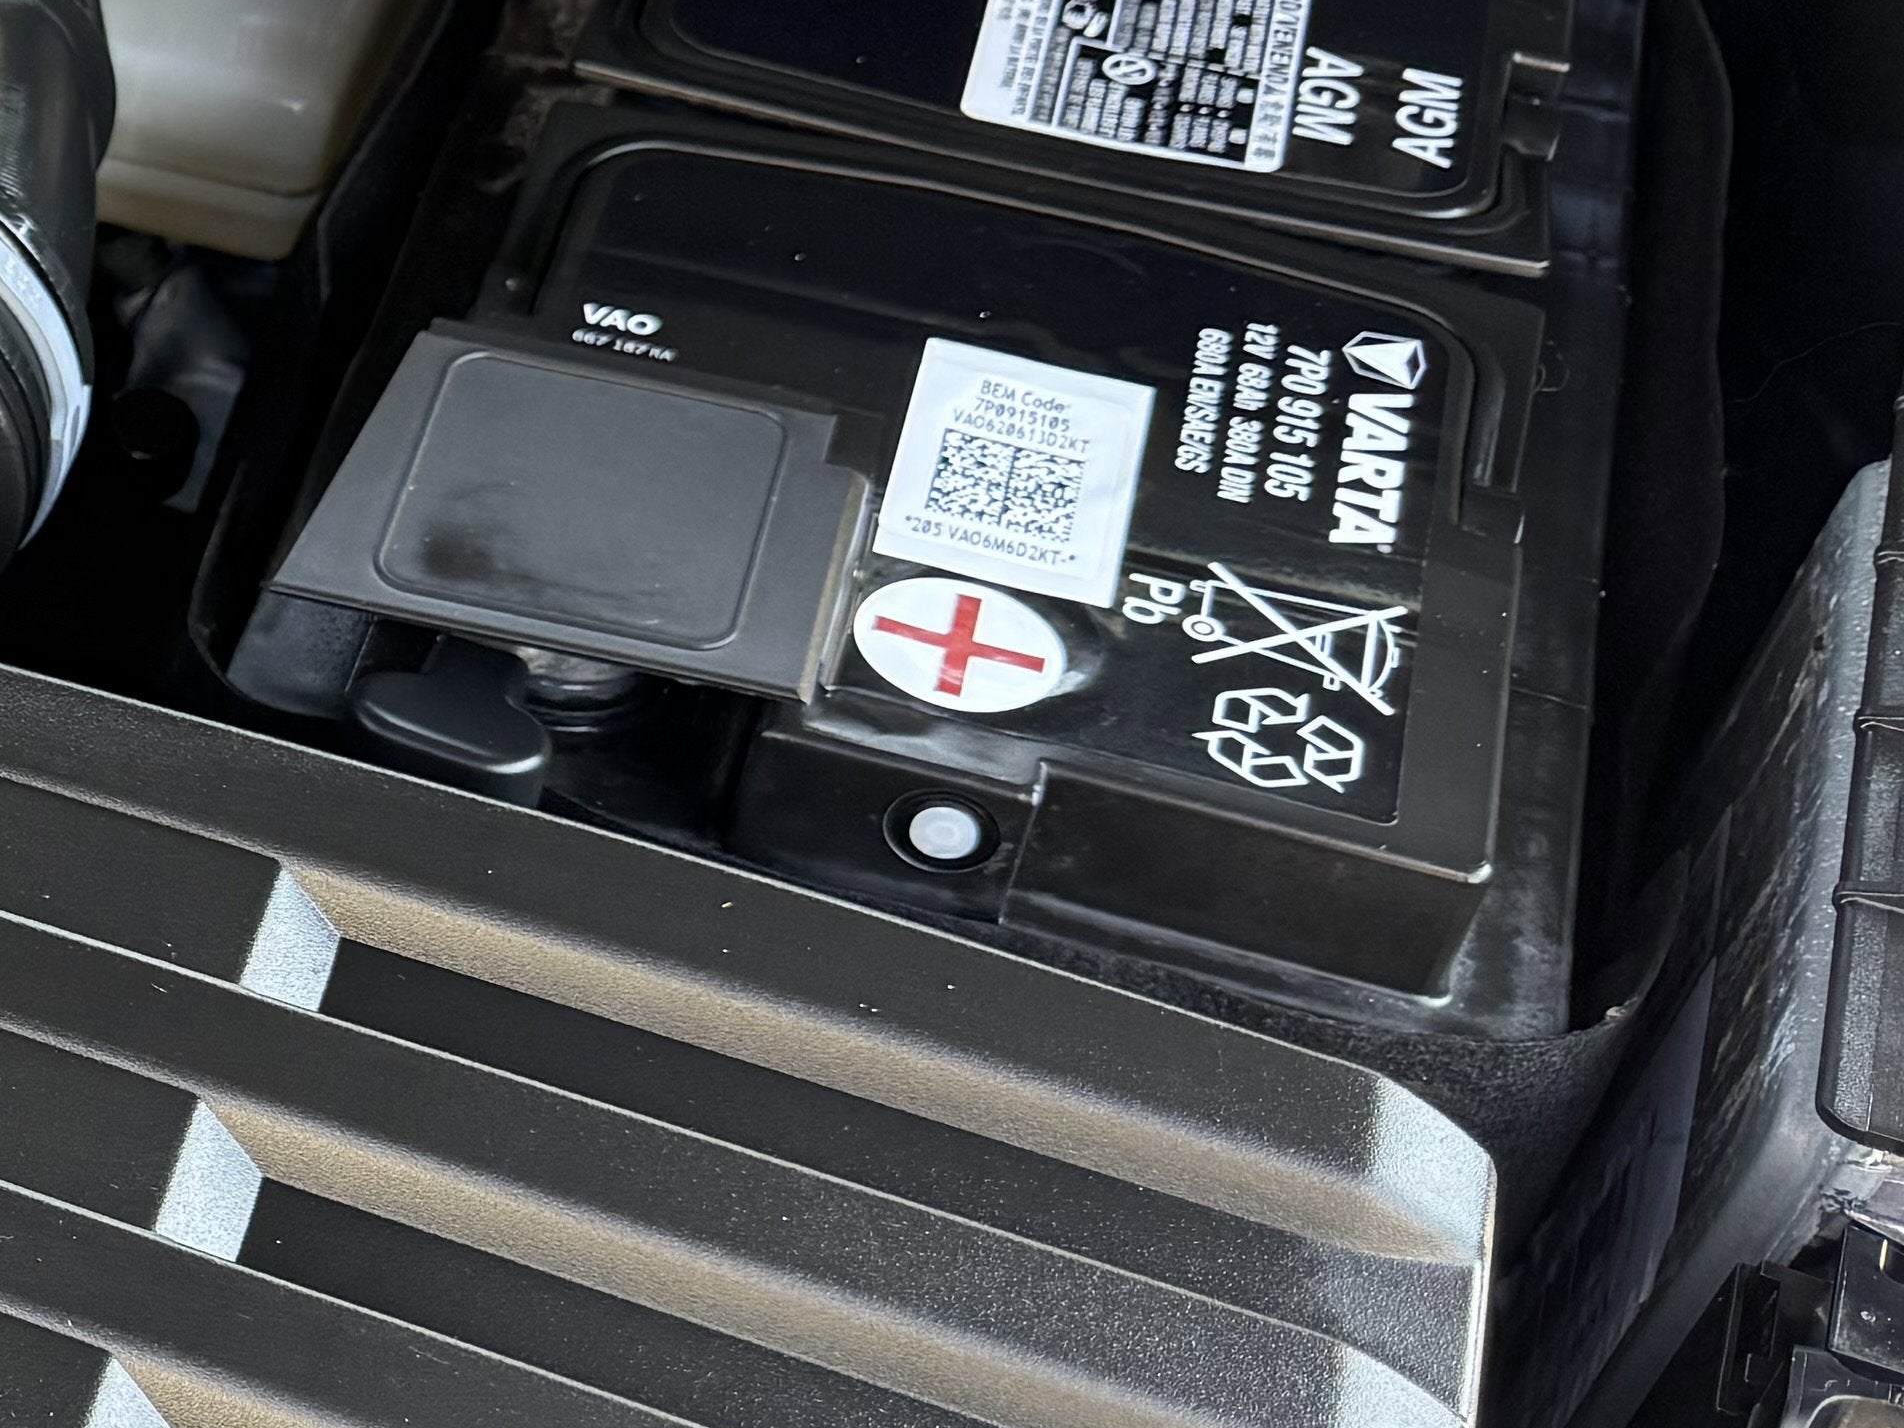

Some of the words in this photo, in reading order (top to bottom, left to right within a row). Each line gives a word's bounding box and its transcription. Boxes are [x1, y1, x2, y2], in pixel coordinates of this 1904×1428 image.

[1291, 45, 1365, 146] AGM
[1391, 67, 1465, 169] AGM
[1190, 327, 1231, 375] 680A
[1241, 323, 1279, 359] 12V
[980, 379, 1016, 401] BEM
[1231, 363, 1272, 411] 68Ah
[974, 397, 1070, 432] 7P0915105
[1173, 376, 1225, 473] EN/SAE/GS
[1271, 396, 1321, 447] 915
[1223, 416, 1265, 465] 380A
[1216, 467, 1256, 504] DIN
[1263, 452, 1314, 502] 105
[1328, 392, 1414, 546] VARTA
[1121, 572, 1187, 625] Pb
